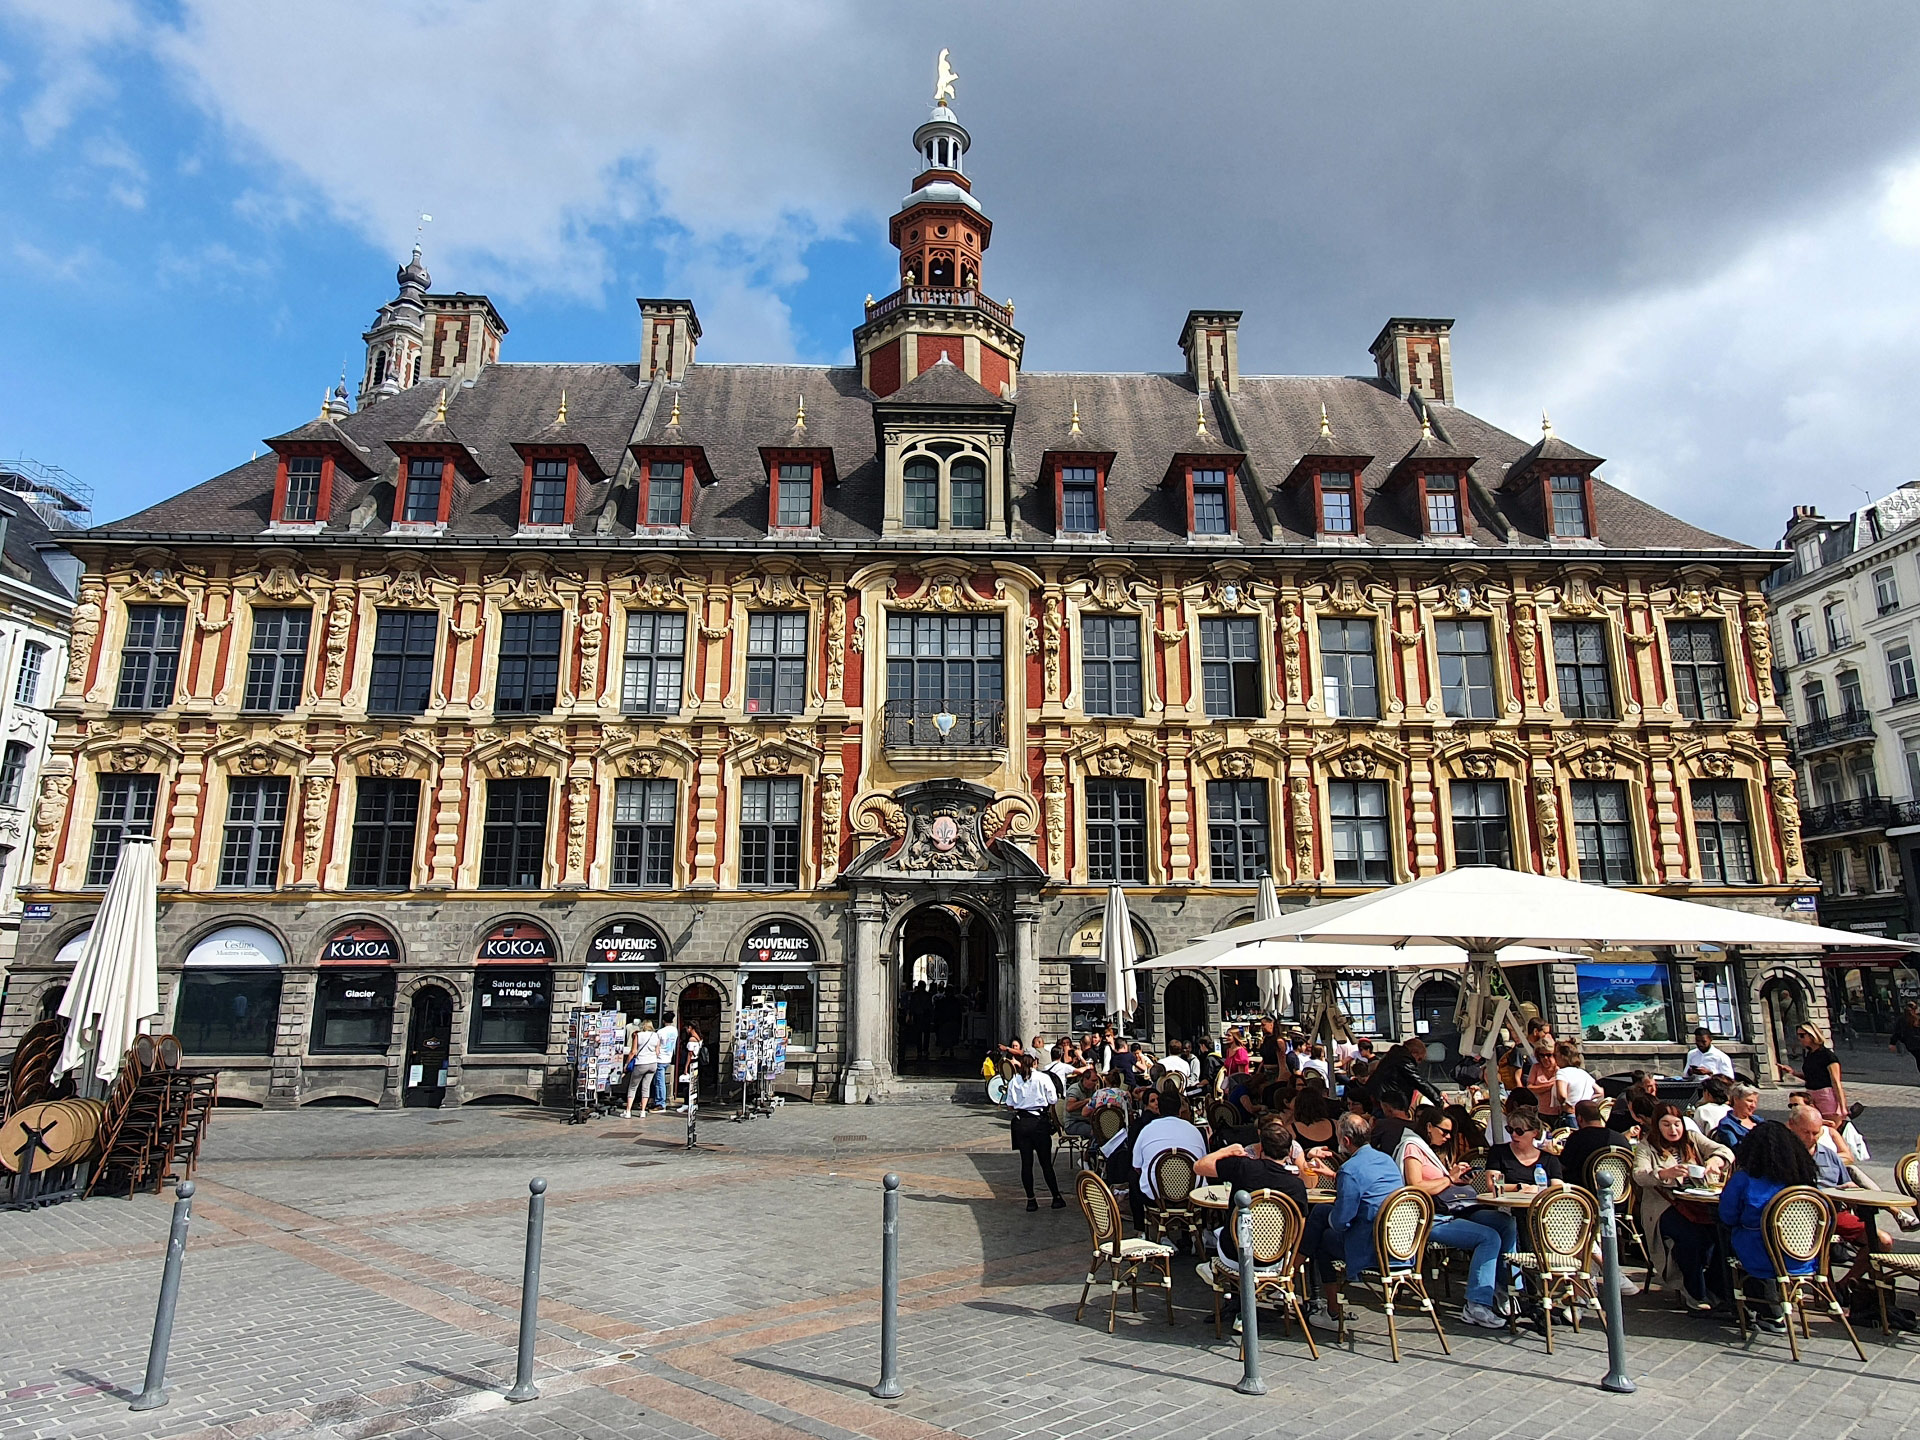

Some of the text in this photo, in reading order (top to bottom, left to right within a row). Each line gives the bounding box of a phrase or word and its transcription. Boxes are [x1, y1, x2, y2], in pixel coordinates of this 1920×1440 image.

[1081, 931, 1093, 940] LA
[487, 941, 546, 955] KOKOA
[595, 938, 657, 950] SOUVENIRS
[747, 938, 809, 950] SOUVENIRS
[330, 942, 390, 957] KOKOA
[619, 951, 645, 961] Lille
[771, 950, 798, 961] Lille
[492, 980, 541, 988] Salon de thé
[345, 990, 376, 998] Glacier
[498, 988, 533, 998] à l'étage
